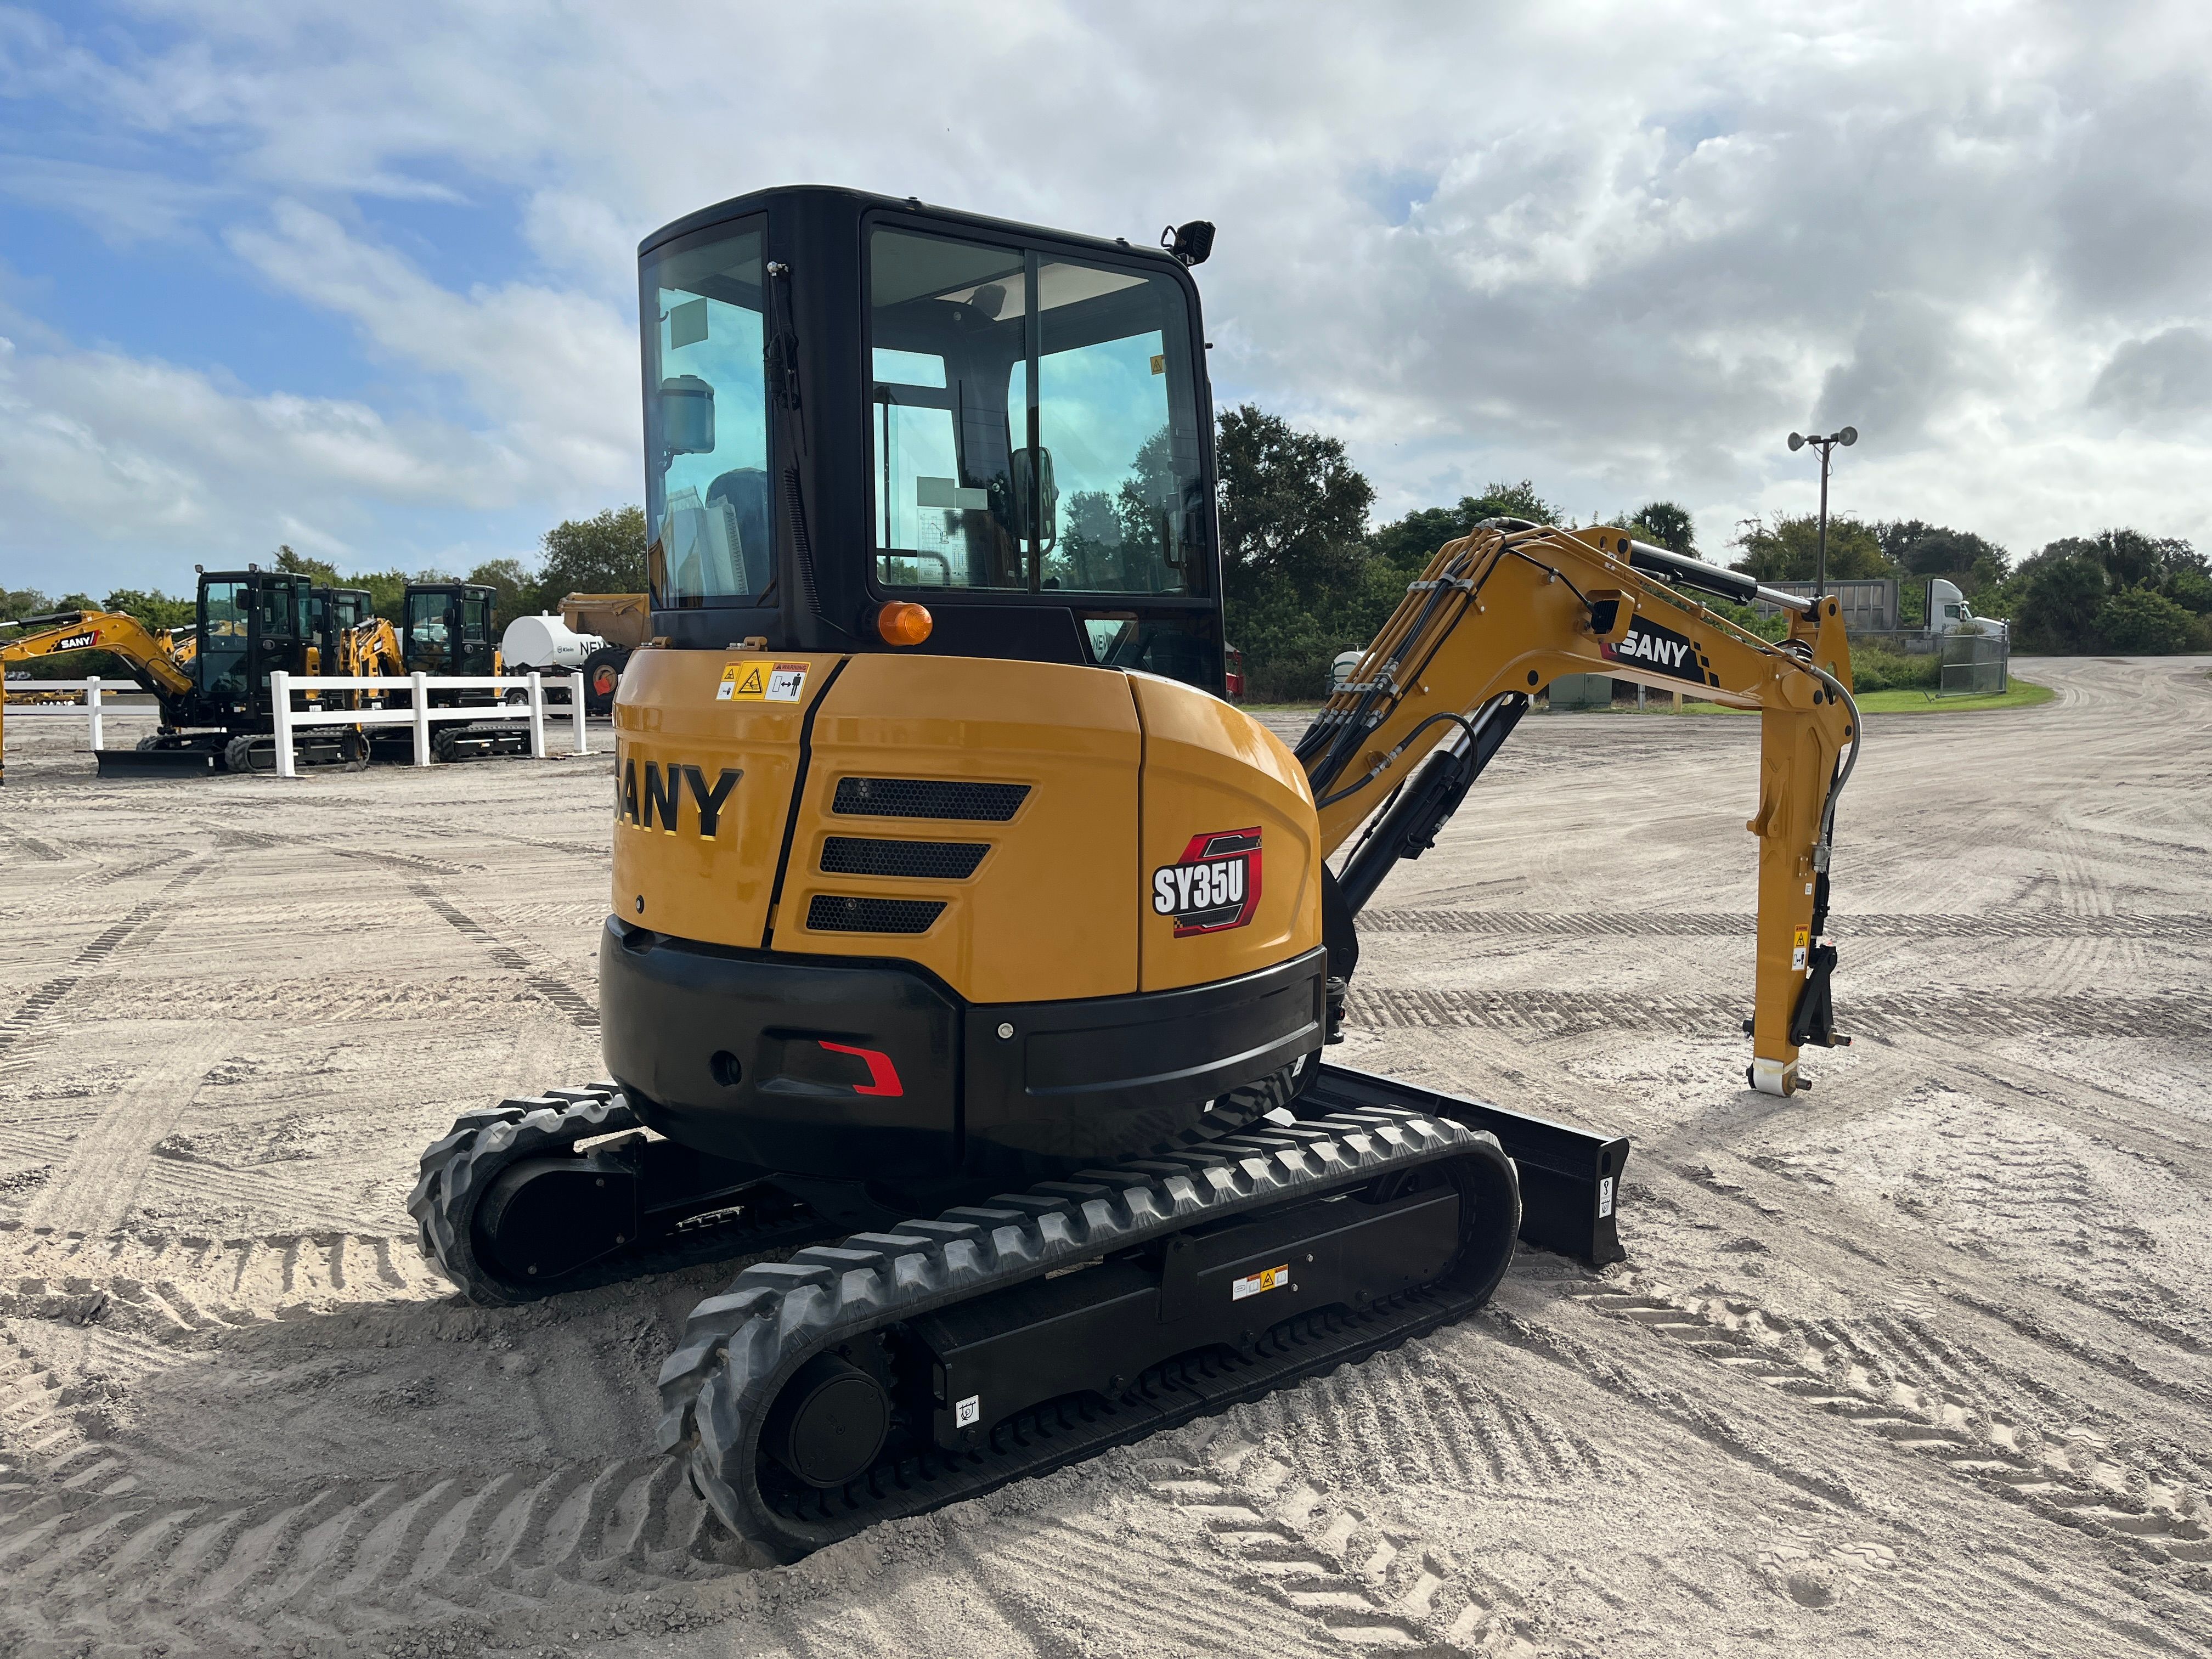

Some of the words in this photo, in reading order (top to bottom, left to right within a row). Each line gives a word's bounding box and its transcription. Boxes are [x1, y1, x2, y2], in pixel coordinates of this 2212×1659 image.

[61, 636, 90, 648] SANY
[1619, 630, 1689, 668] SANY
[614, 754, 744, 841] ANY
[1155, 859, 1243, 913] SY35U
